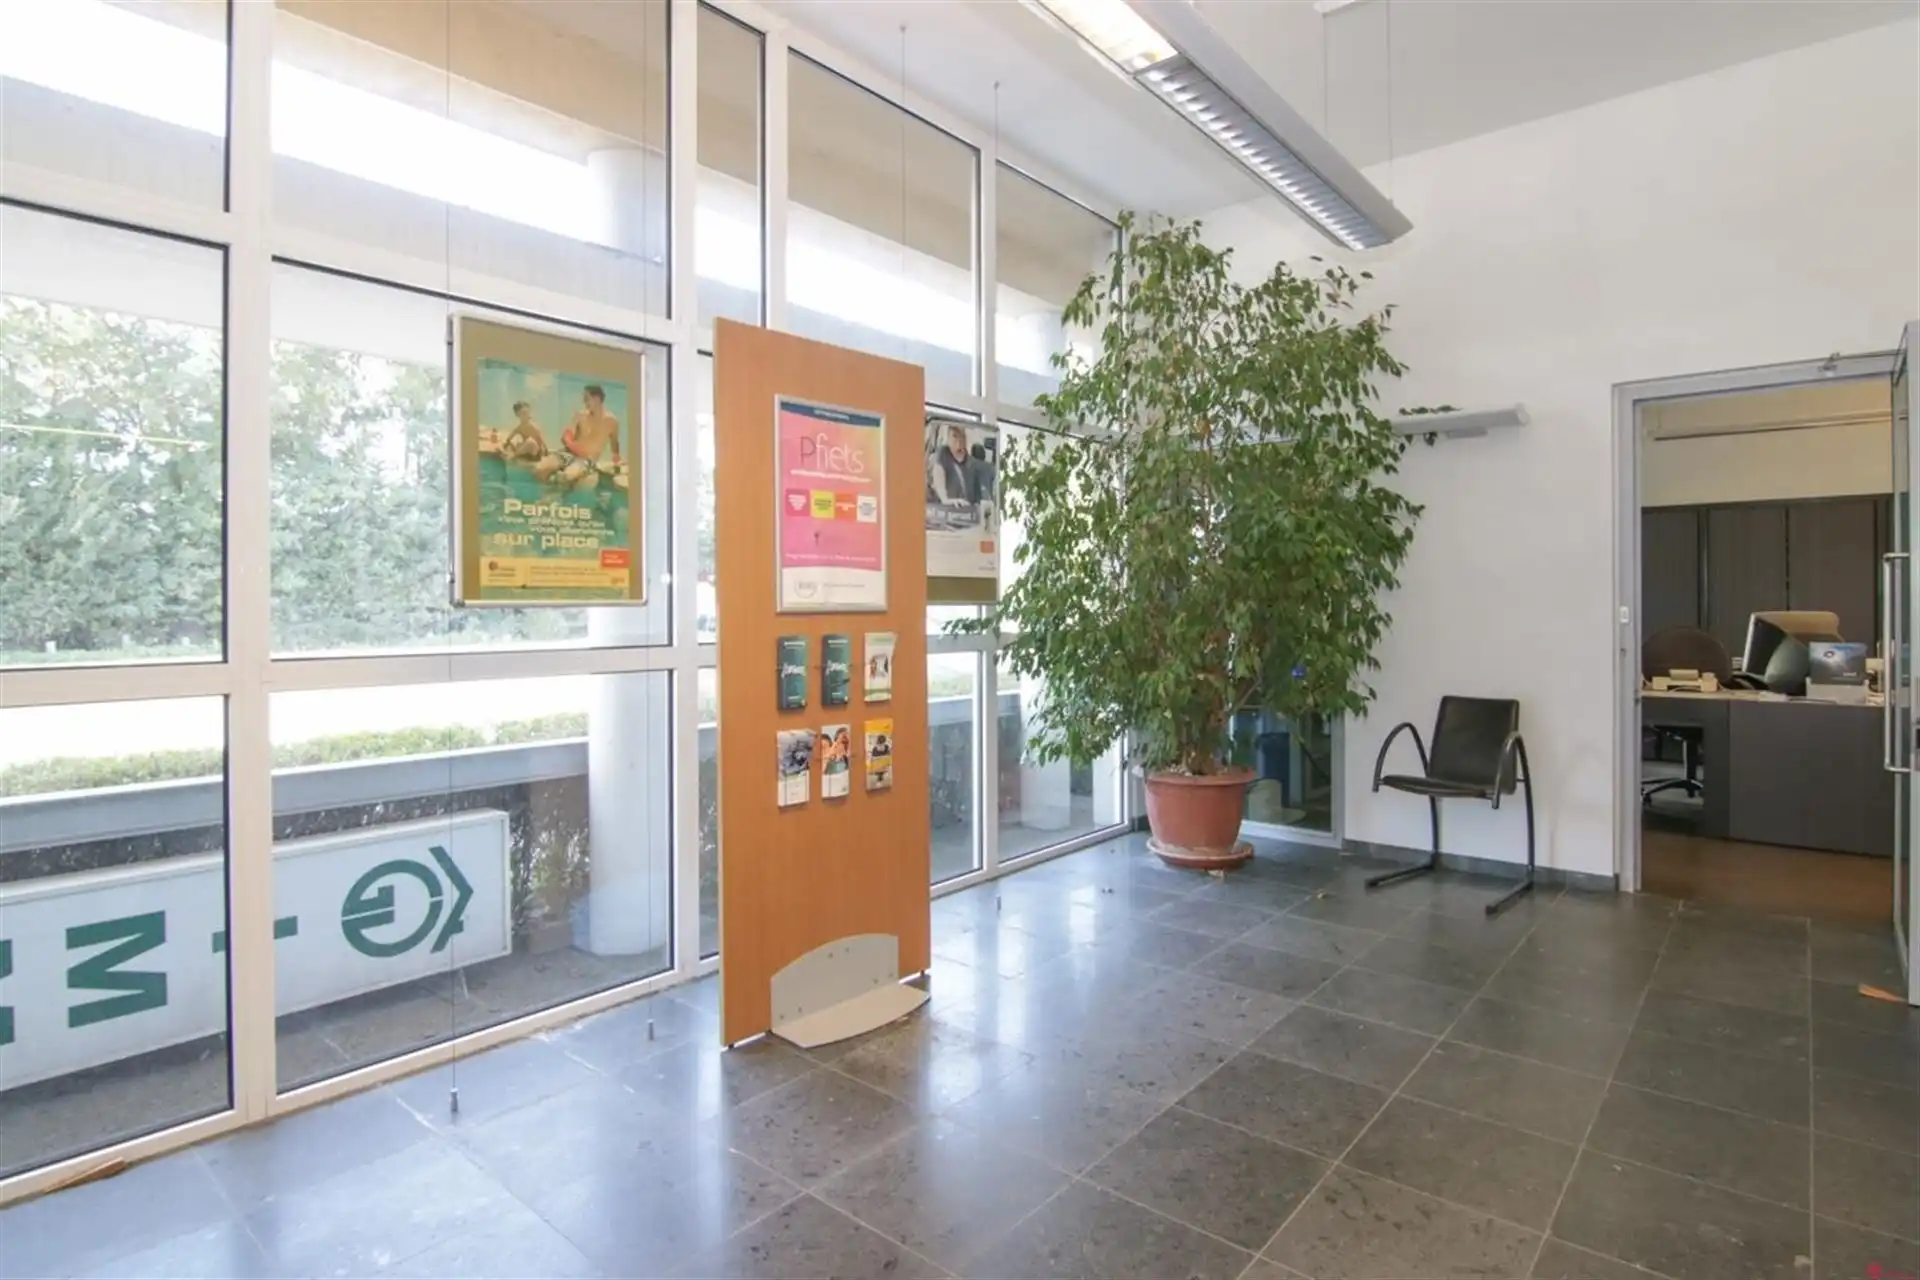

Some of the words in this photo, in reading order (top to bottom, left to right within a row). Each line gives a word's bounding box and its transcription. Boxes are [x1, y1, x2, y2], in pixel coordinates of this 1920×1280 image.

[503, 498, 592, 519] Parfois
[493, 532, 535, 546] sur
[541, 532, 599, 550] place
